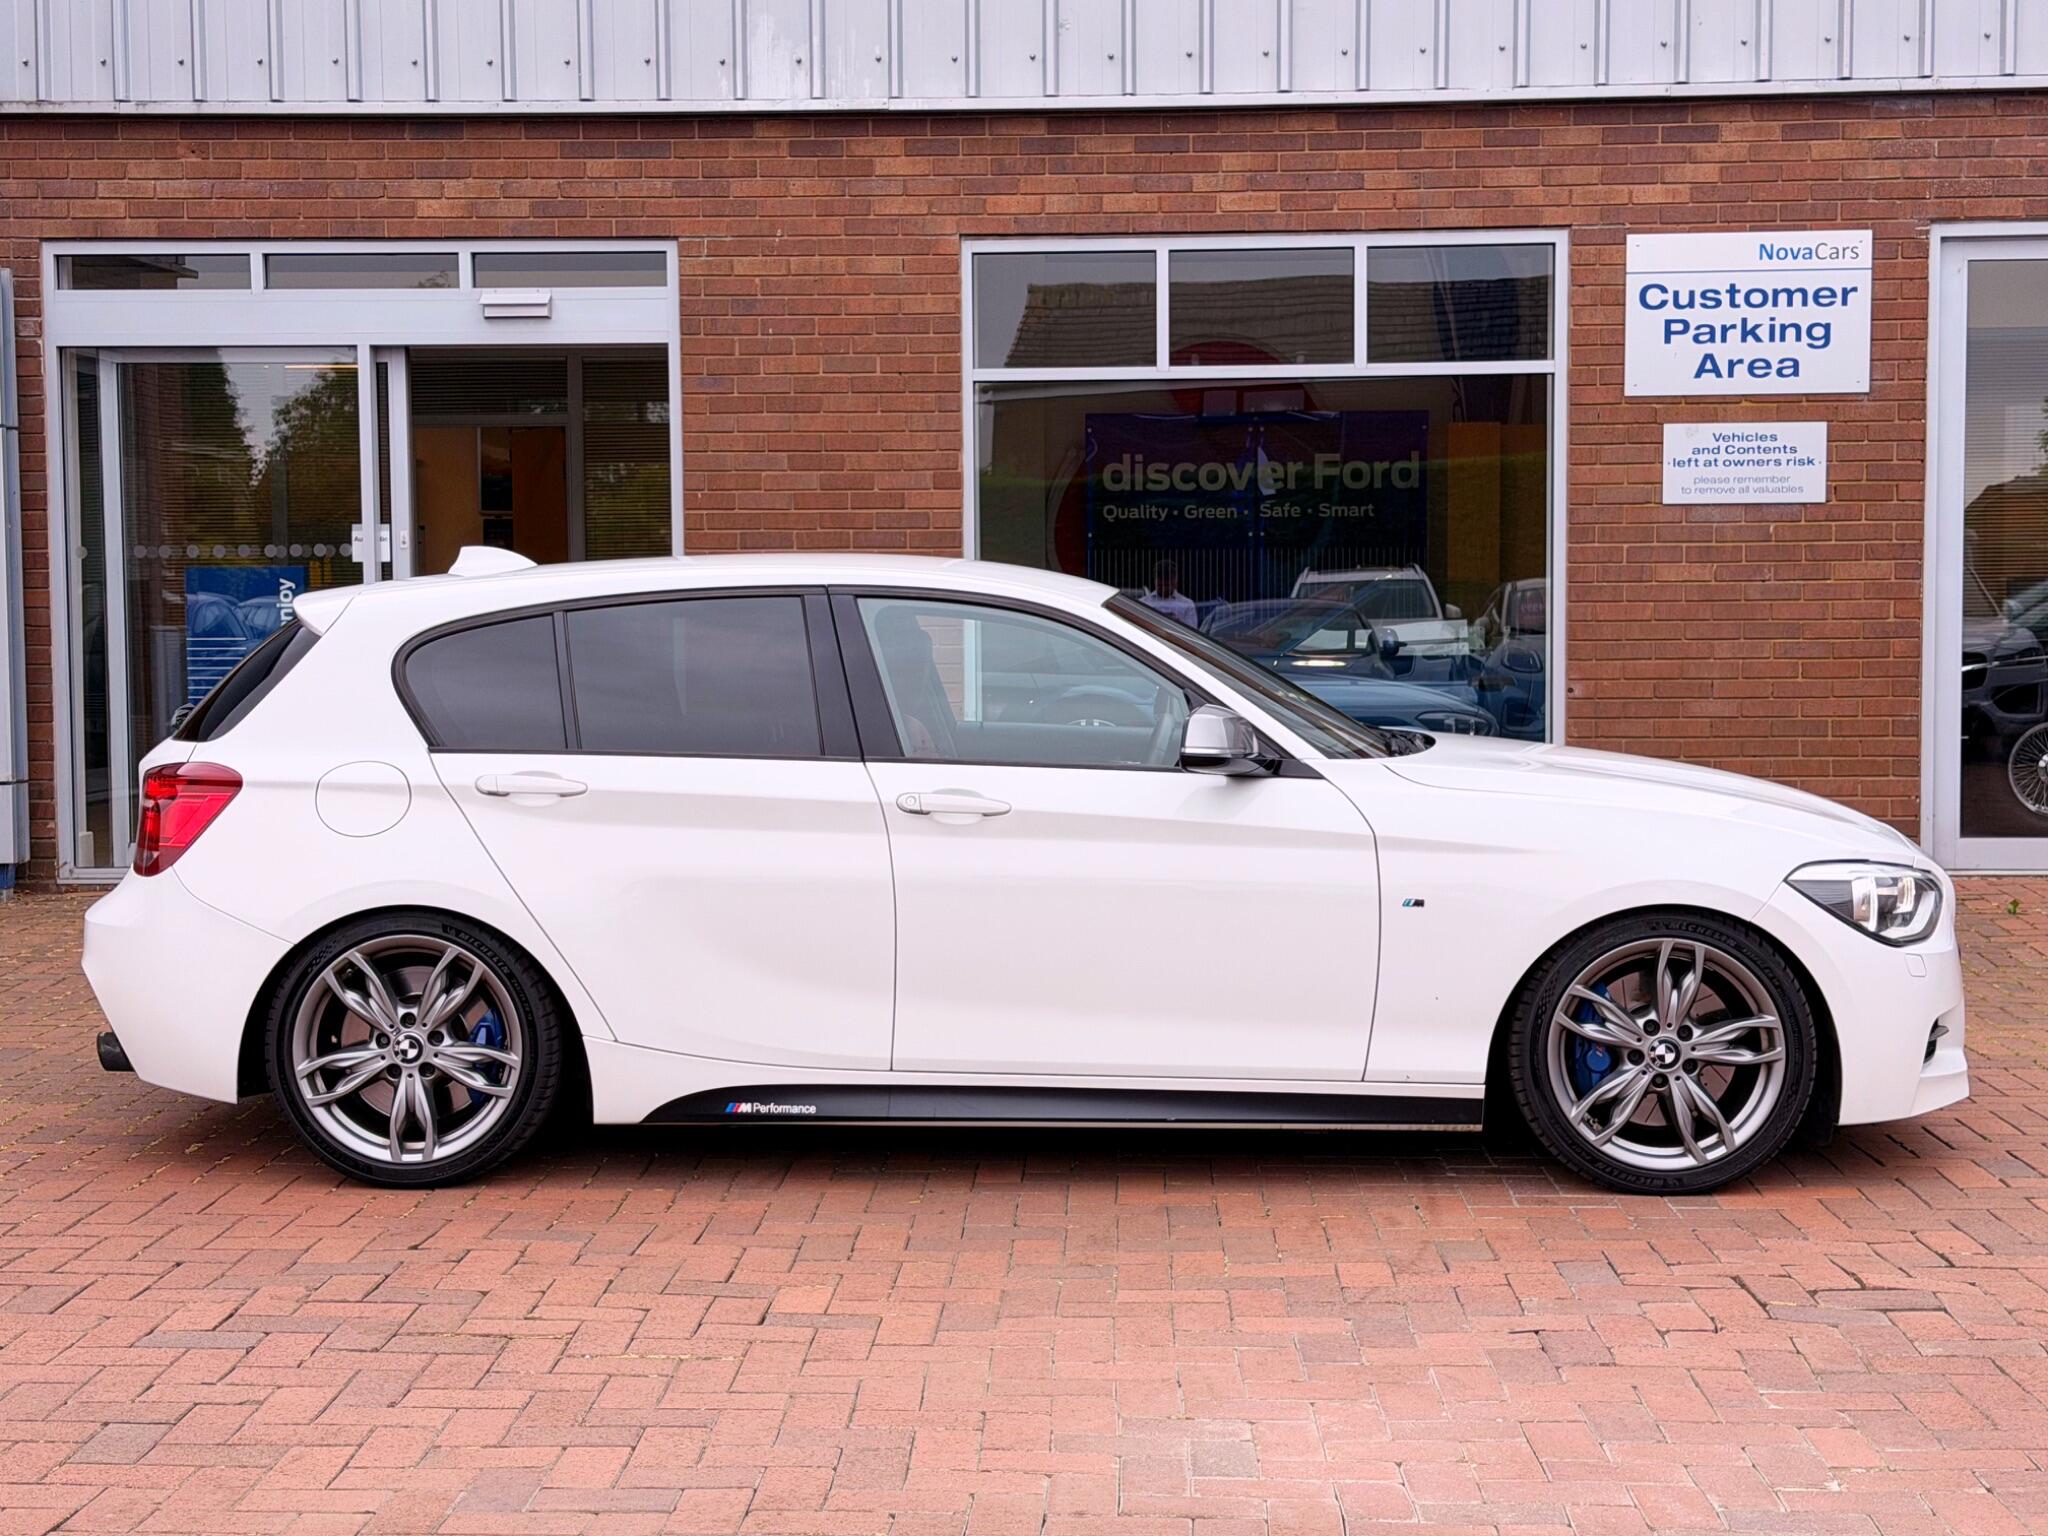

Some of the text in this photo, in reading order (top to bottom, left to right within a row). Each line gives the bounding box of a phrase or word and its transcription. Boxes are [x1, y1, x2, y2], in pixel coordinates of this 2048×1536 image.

[1759, 243, 1860, 260] NovaCars
[1638, 283, 1858, 310] Customer
[1664, 317, 1832, 349] Parking
[1693, 353, 1800, 379] Area
[1712, 432, 1778, 442] Vehicles
[1691, 444, 1798, 455] and Contents
[1102, 450, 1420, 491] discover Ford
[1672, 456, 1815, 468] left at owners risk
[1693, 475, 1791, 485] please remember
[1681, 486, 1692, 494] to
[1738, 485, 1749, 494] all
[1752, 484, 1804, 494] valuables
[1103, 502, 1375, 522] Quality Green Safe Smart
[276, 577, 296, 627] njoy
[753, 1102, 817, 1114] Performance
